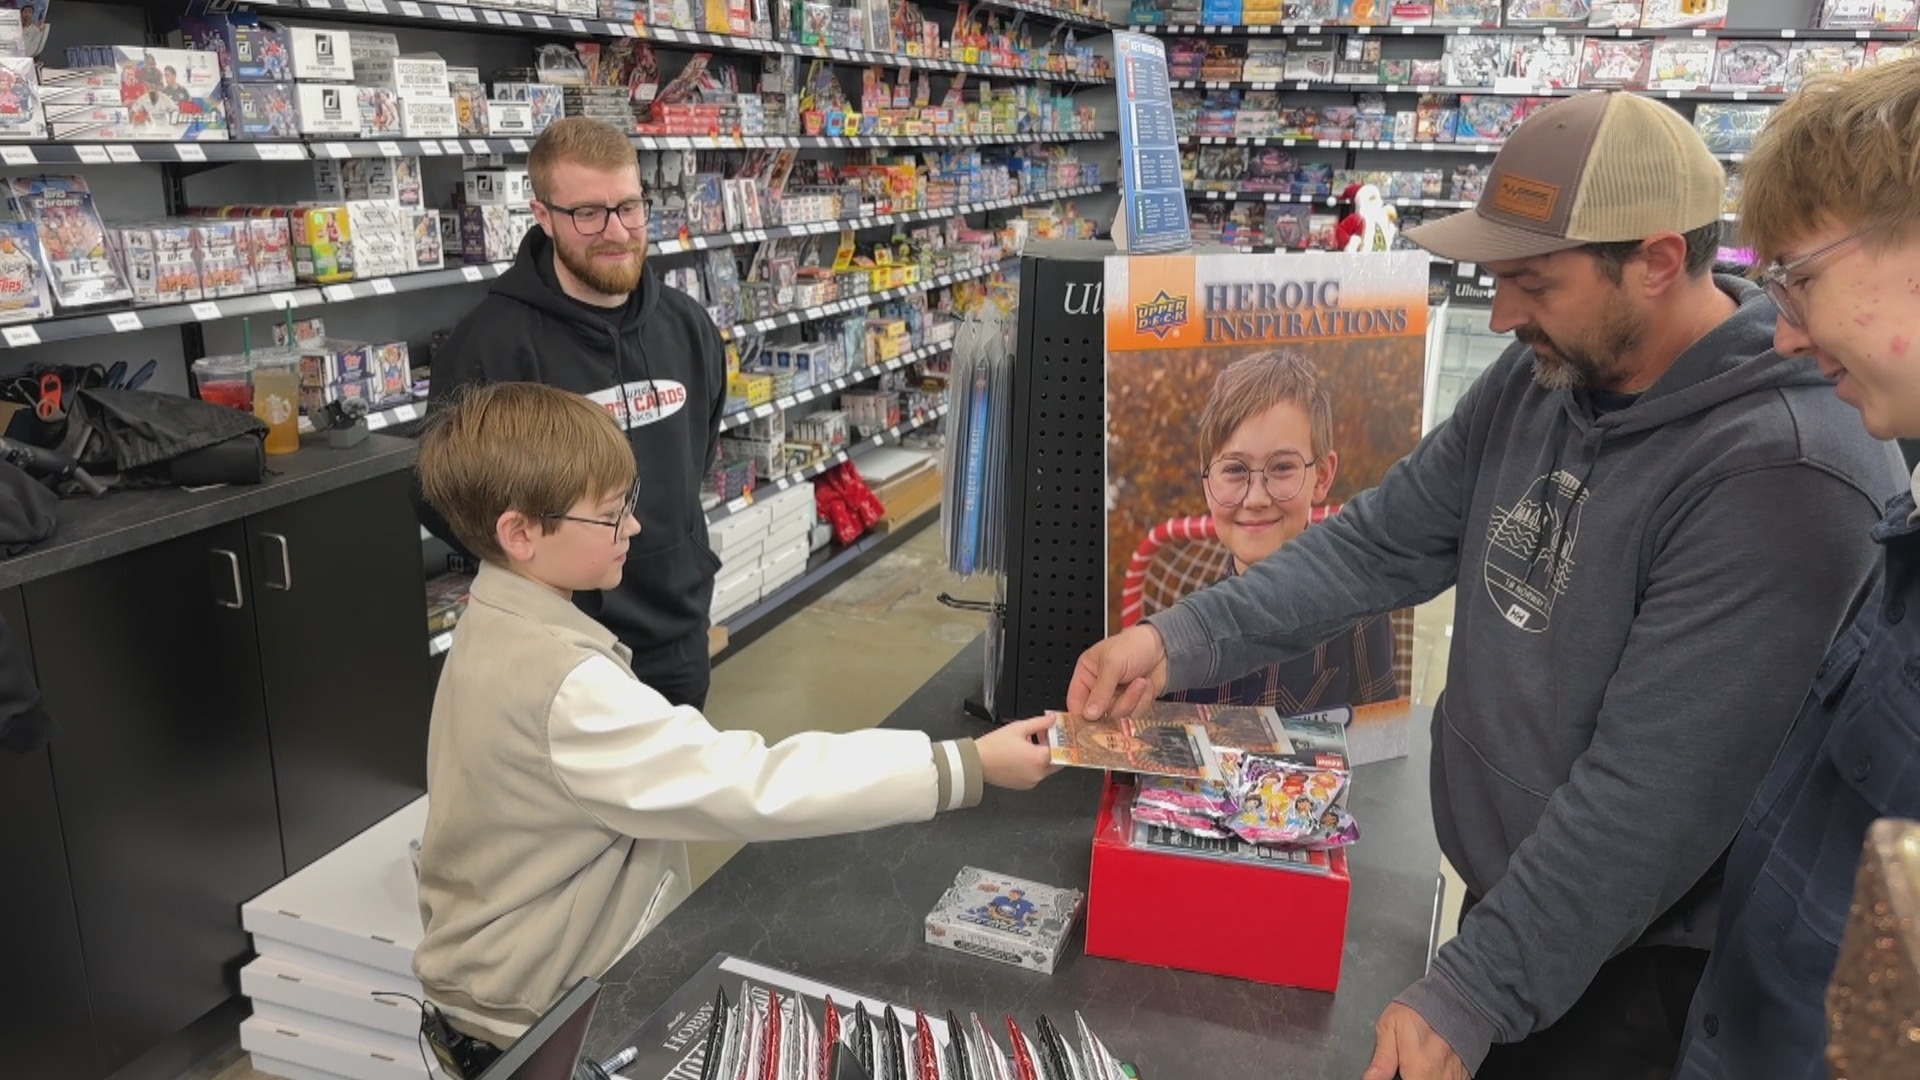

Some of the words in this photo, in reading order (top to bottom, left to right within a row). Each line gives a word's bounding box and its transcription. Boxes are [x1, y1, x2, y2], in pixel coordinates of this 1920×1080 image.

[71, 262, 99, 275] UFC
[1138, 300, 1185, 319] UPPER
[1204, 281, 1340, 312] HEROIC
[1204, 308, 1407, 342] INSPIRATIONS
[634, 386, 684, 412] CARDS
